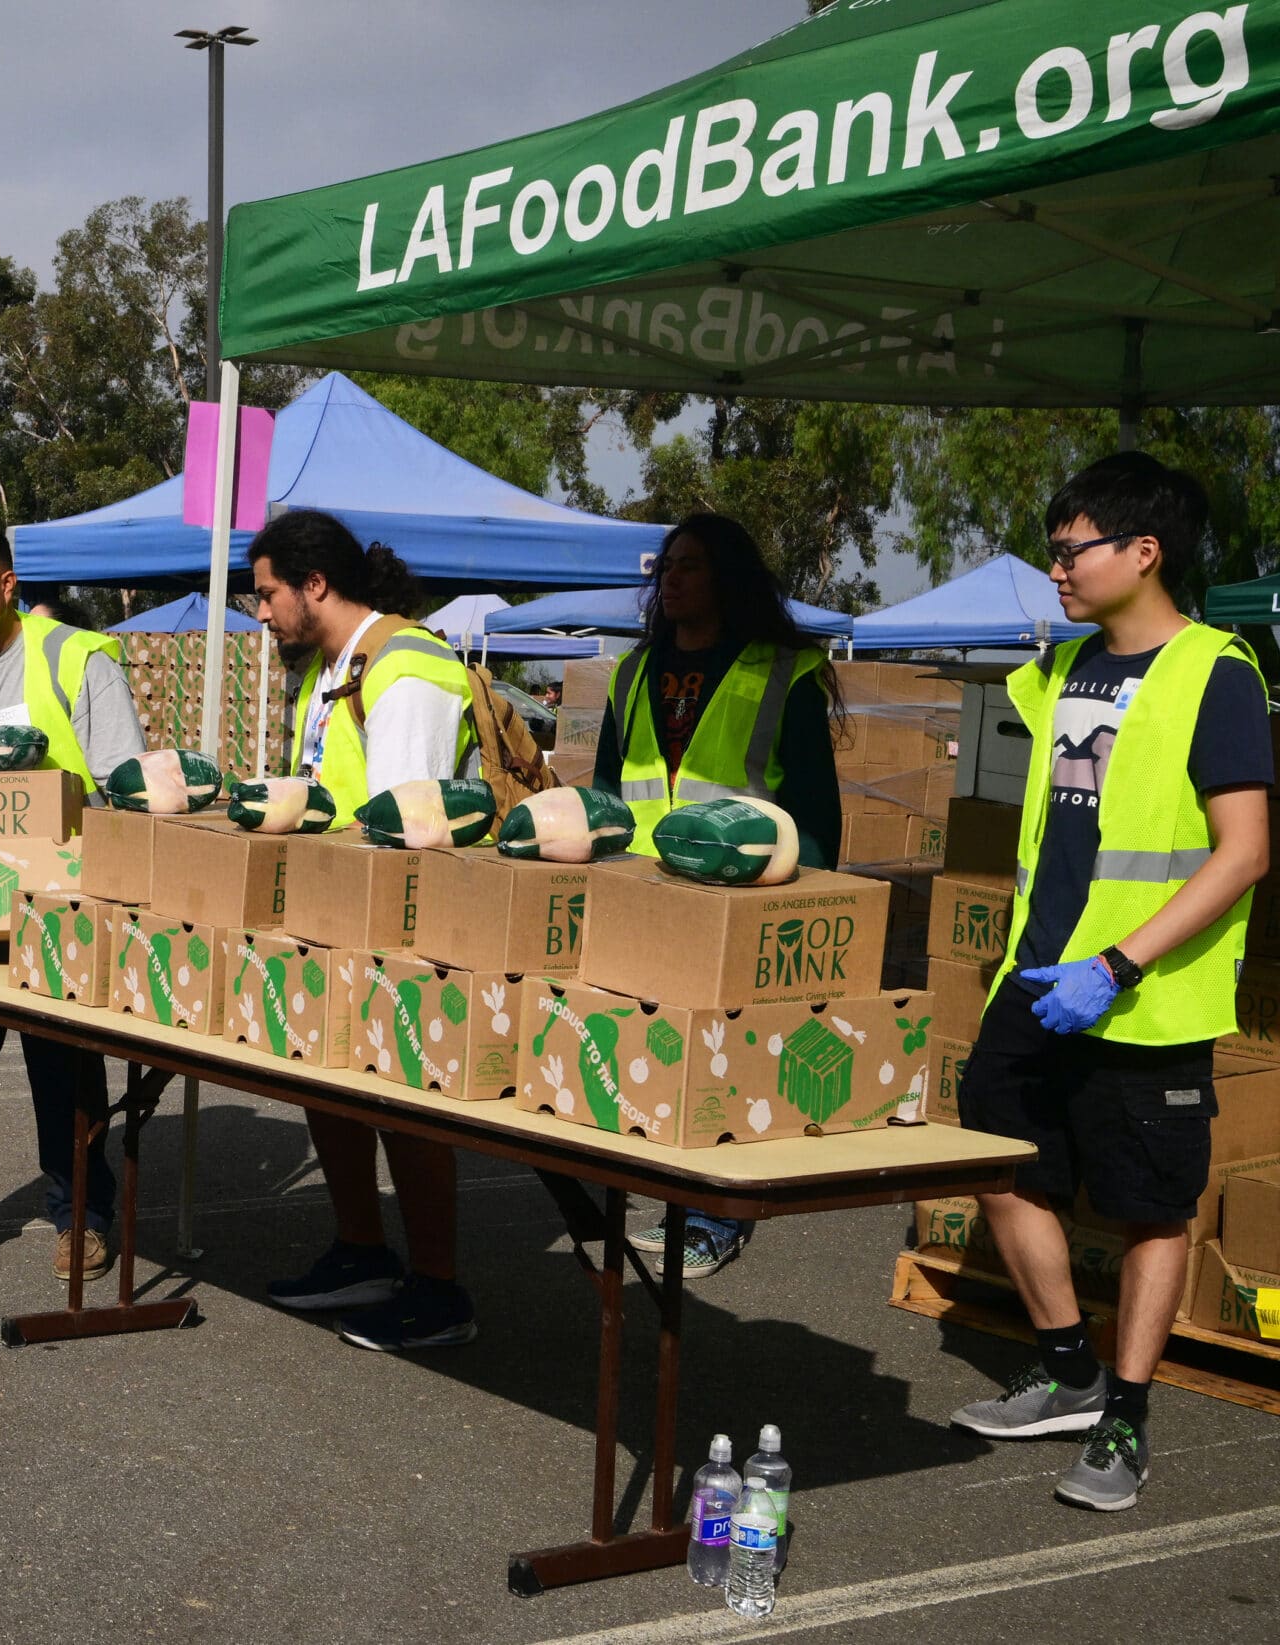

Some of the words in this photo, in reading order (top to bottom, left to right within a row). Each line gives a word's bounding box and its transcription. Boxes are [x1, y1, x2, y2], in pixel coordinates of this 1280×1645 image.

[356, 4, 1250, 292] LAFoodBank.org
[551, 875, 569, 885] LOS
[763, 901, 779, 912] LOS
[780, 899, 816, 910] ANGELES
[817, 895, 857, 906] REGIONAL
[19, 902, 48, 935] PRODUCE
[44, 931, 53, 949] TO
[49, 946, 62, 972] THE
[59, 967, 84, 997] PEOPLE
[755, 949, 848, 988] BANK
[759, 916, 855, 955] FOOD
[122, 922, 154, 957] PRODUCE
[151, 954, 161, 972] TO
[158, 969, 171, 997] THE
[168, 993, 197, 1025] PEOPLE
[237, 944, 271, 982] PRODUCE
[266, 979, 277, 1000] TO
[273, 998, 287, 1027] THE
[283, 1023, 313, 1057] PEOPLE
[806, 991, 827, 1001] Giving
[828, 989, 846, 1000] Hope
[364, 967, 403, 1008] PRODUCE
[397, 1005, 410, 1027] TO
[406, 1025, 421, 1056] THE
[417, 1051, 452, 1088] PEOPLE
[538, 996, 591, 1043] PRODUCE
[586, 1040, 601, 1064] TO
[596, 1063, 617, 1096] THE
[613, 1092, 661, 1135] PEOPLE
[896, 1091, 921, 1104] FRESH
